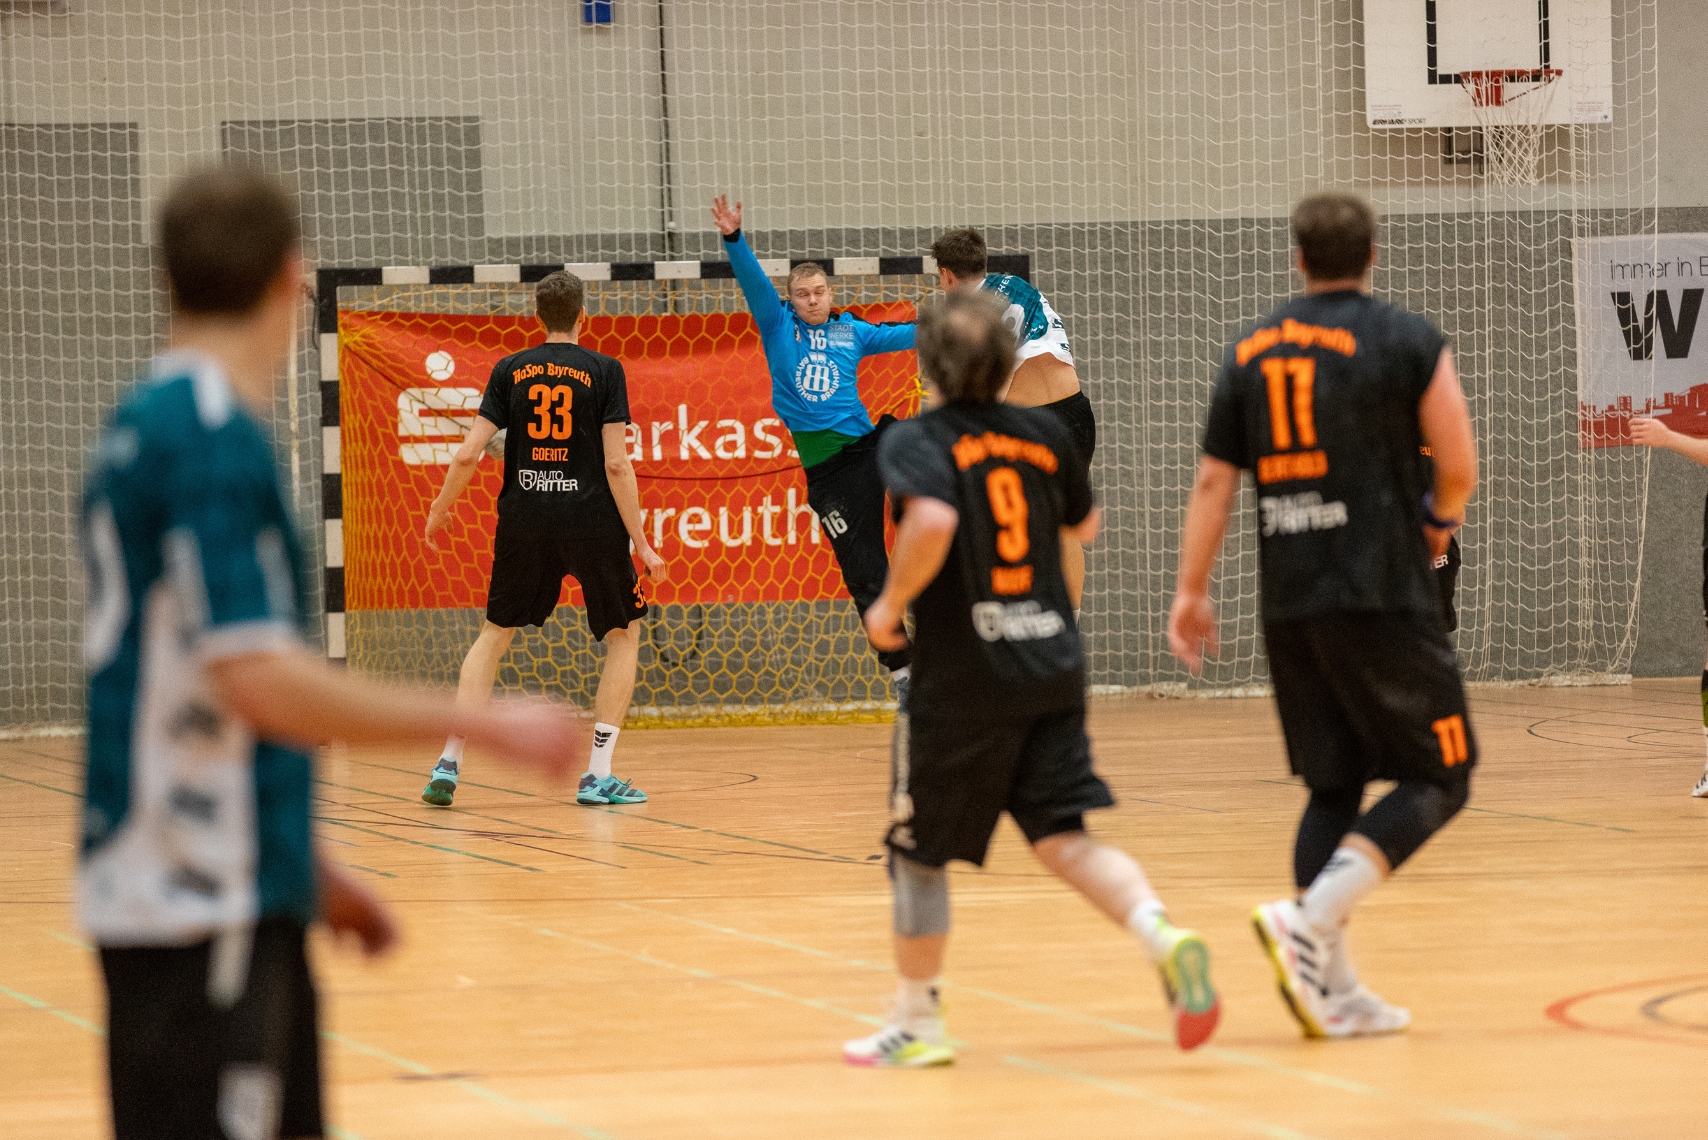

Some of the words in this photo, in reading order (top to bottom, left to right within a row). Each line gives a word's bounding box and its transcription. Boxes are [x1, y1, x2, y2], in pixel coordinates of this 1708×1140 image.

[1610, 258, 1672, 280] immer
[1676, 256, 1693, 277] in
[1610, 288, 1704, 360] W
[807, 329, 827, 350] 16
[513, 363, 544, 385] HaSpo
[528, 383, 573, 440] 33
[624, 403, 800, 462] arkas
[532, 447, 569, 462] GOERITZ
[536, 479, 578, 492] RITTER
[538, 470, 564, 481] AUTO
[630, 488, 821, 555] reuth
[821, 510, 848, 539] 16
[986, 465, 1030, 563] 9
